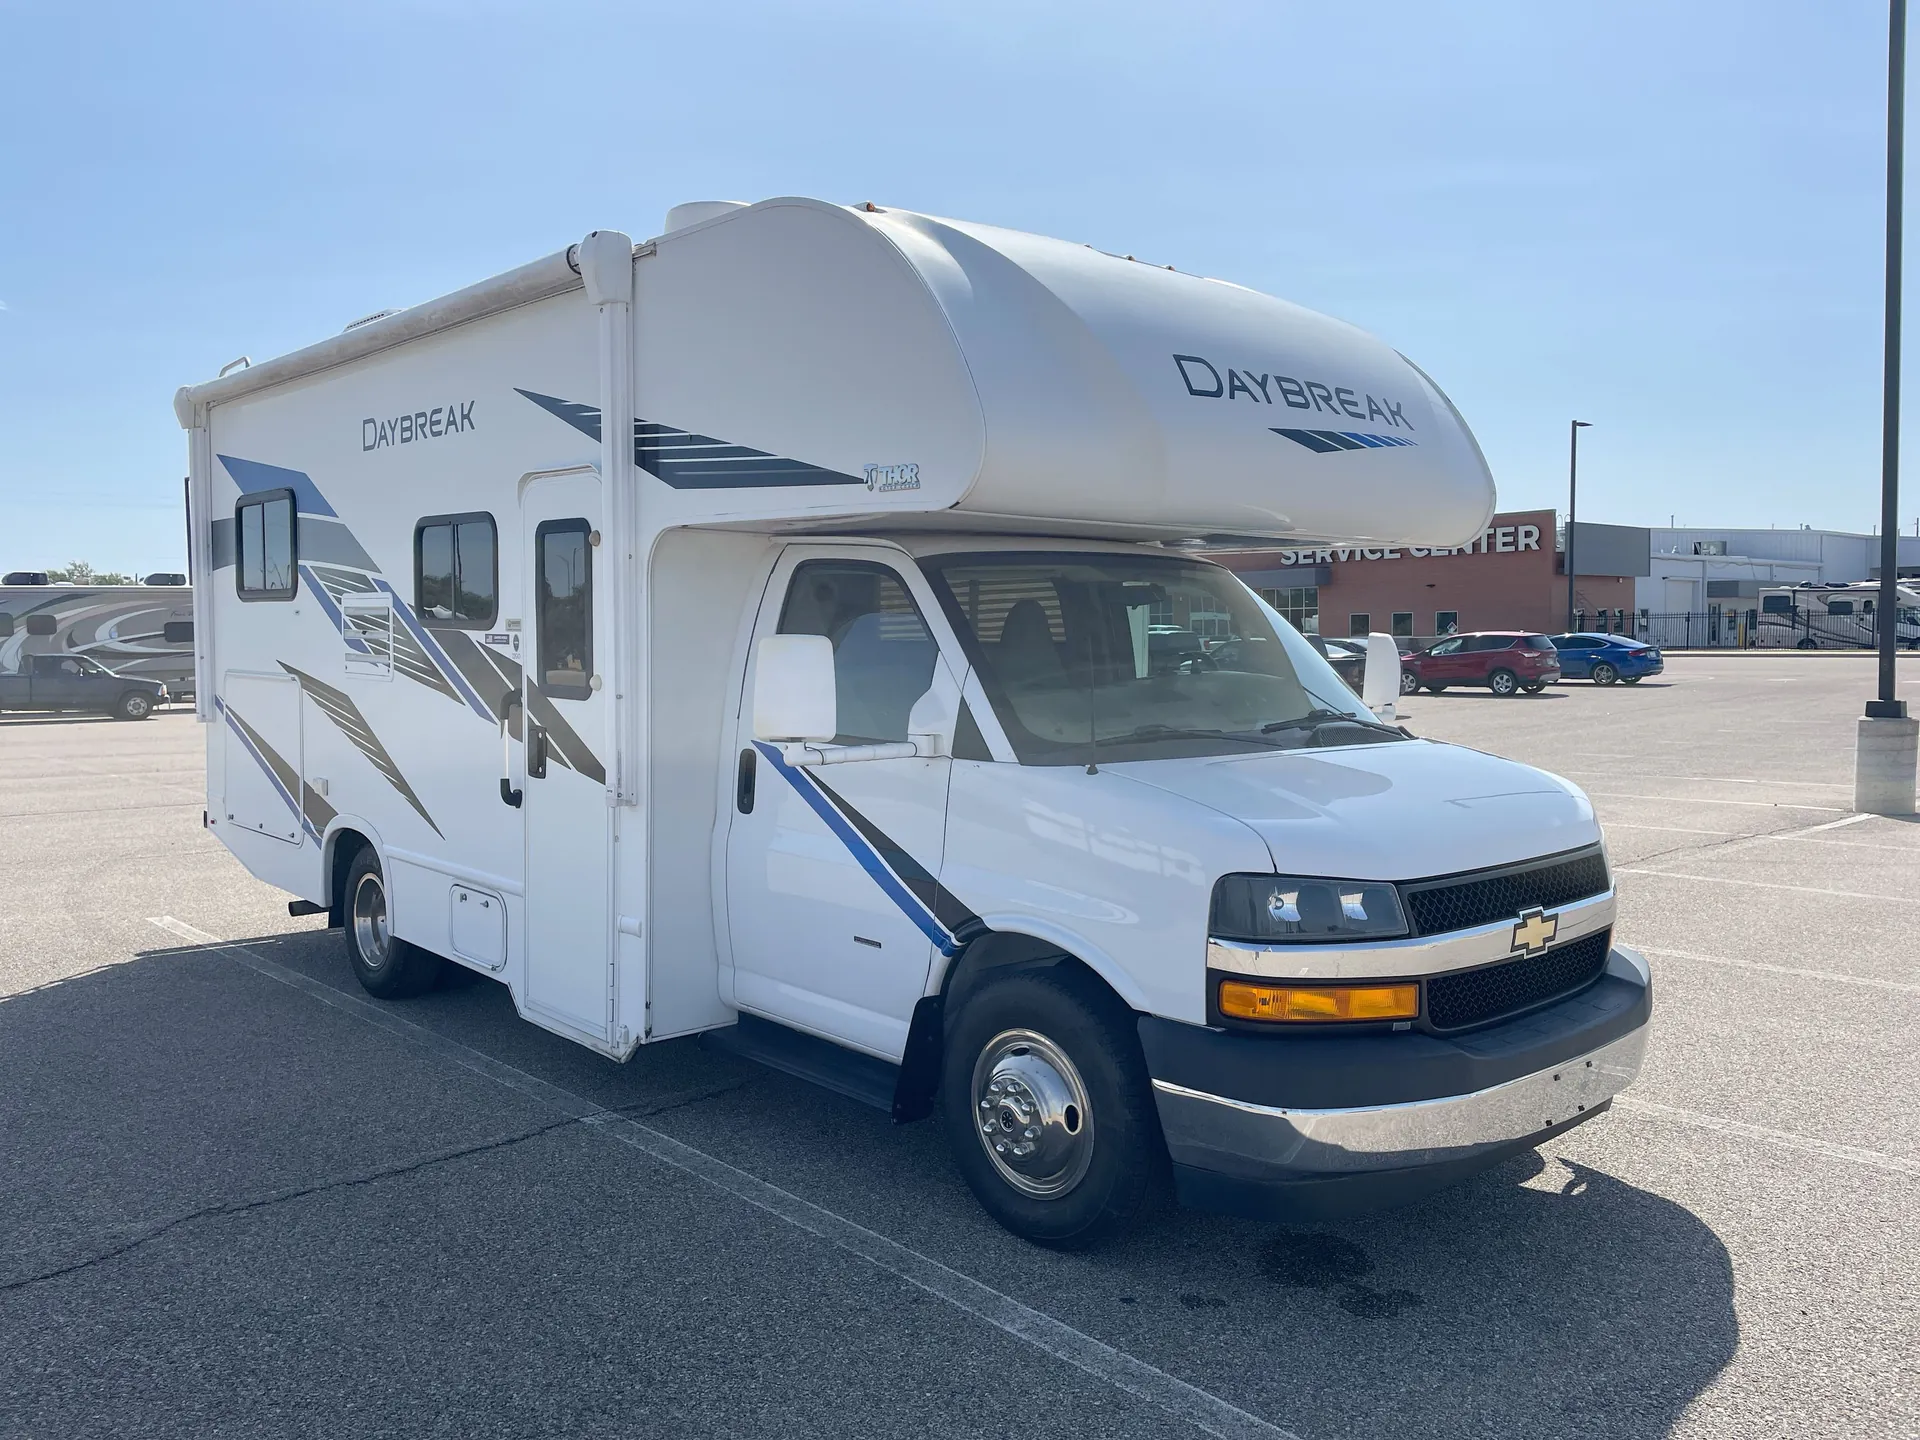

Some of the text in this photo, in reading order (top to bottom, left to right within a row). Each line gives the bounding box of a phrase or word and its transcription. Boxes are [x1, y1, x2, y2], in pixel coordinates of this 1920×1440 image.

[1172, 353, 1415, 431] DAYBREAK
[362, 400, 475, 452] DAYBREAK
[878, 463, 920, 486] THOR
